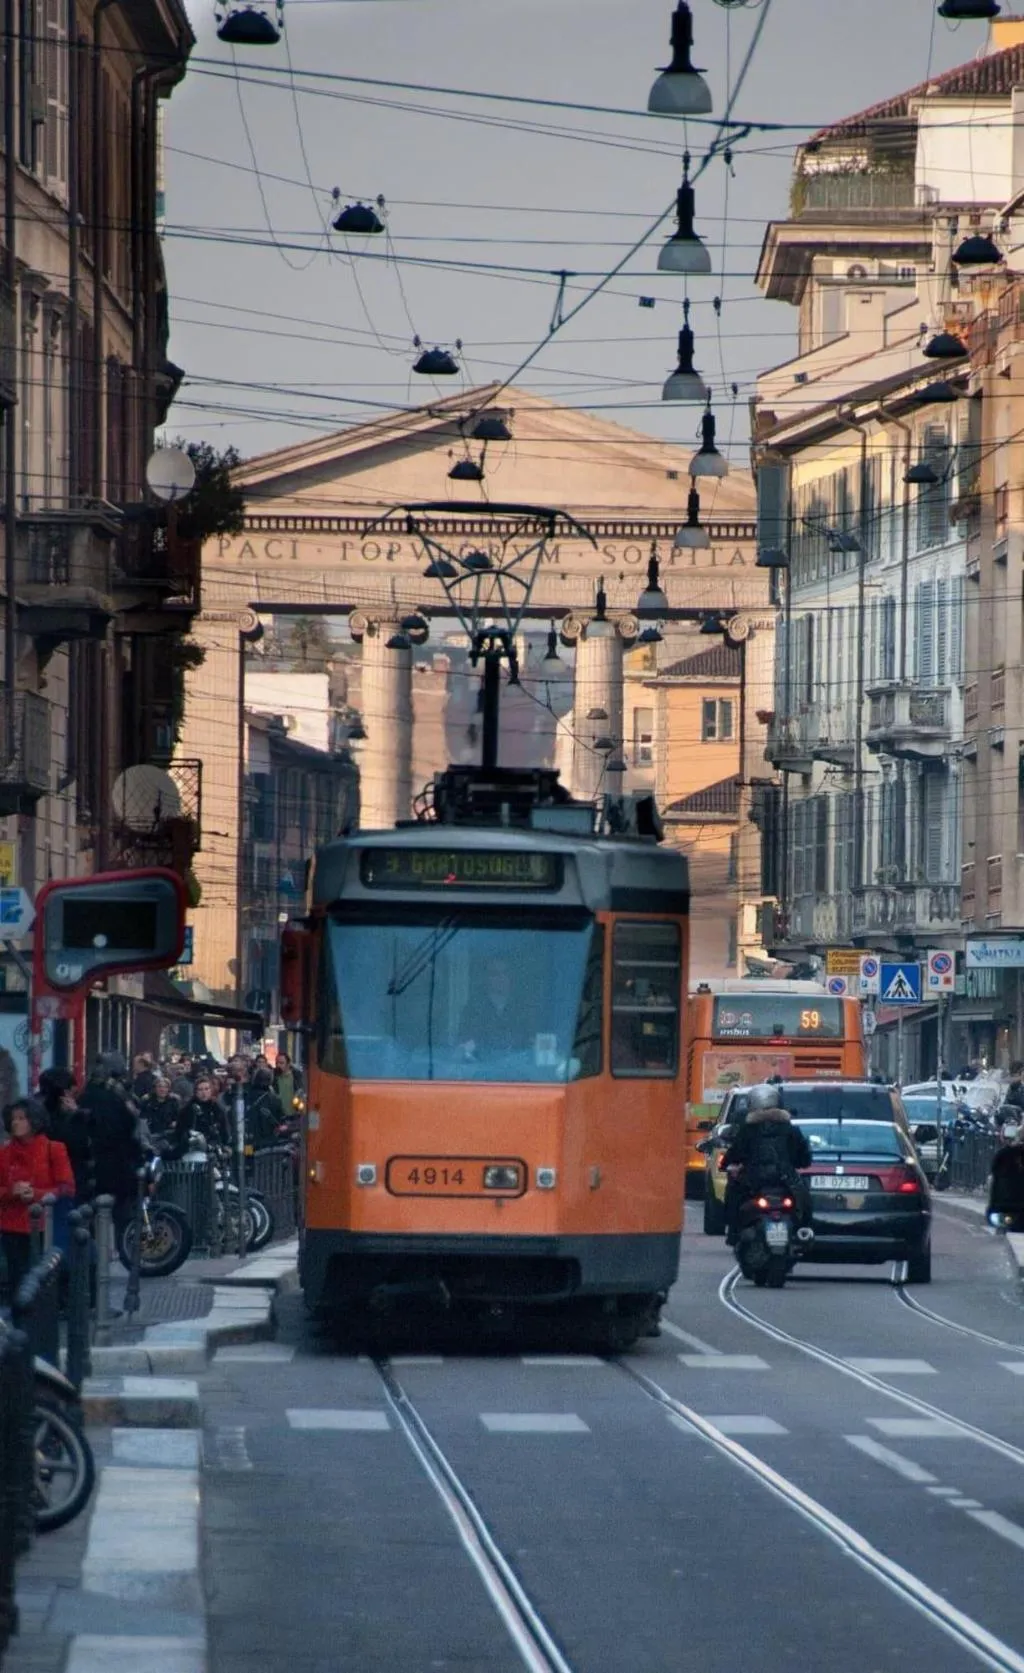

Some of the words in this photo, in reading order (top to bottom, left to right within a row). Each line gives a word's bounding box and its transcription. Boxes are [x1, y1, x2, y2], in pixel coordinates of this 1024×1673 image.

[216, 538, 299, 560] PACI
[800, 1010, 820, 1029] 59
[407, 1167, 465, 1186] 4914
